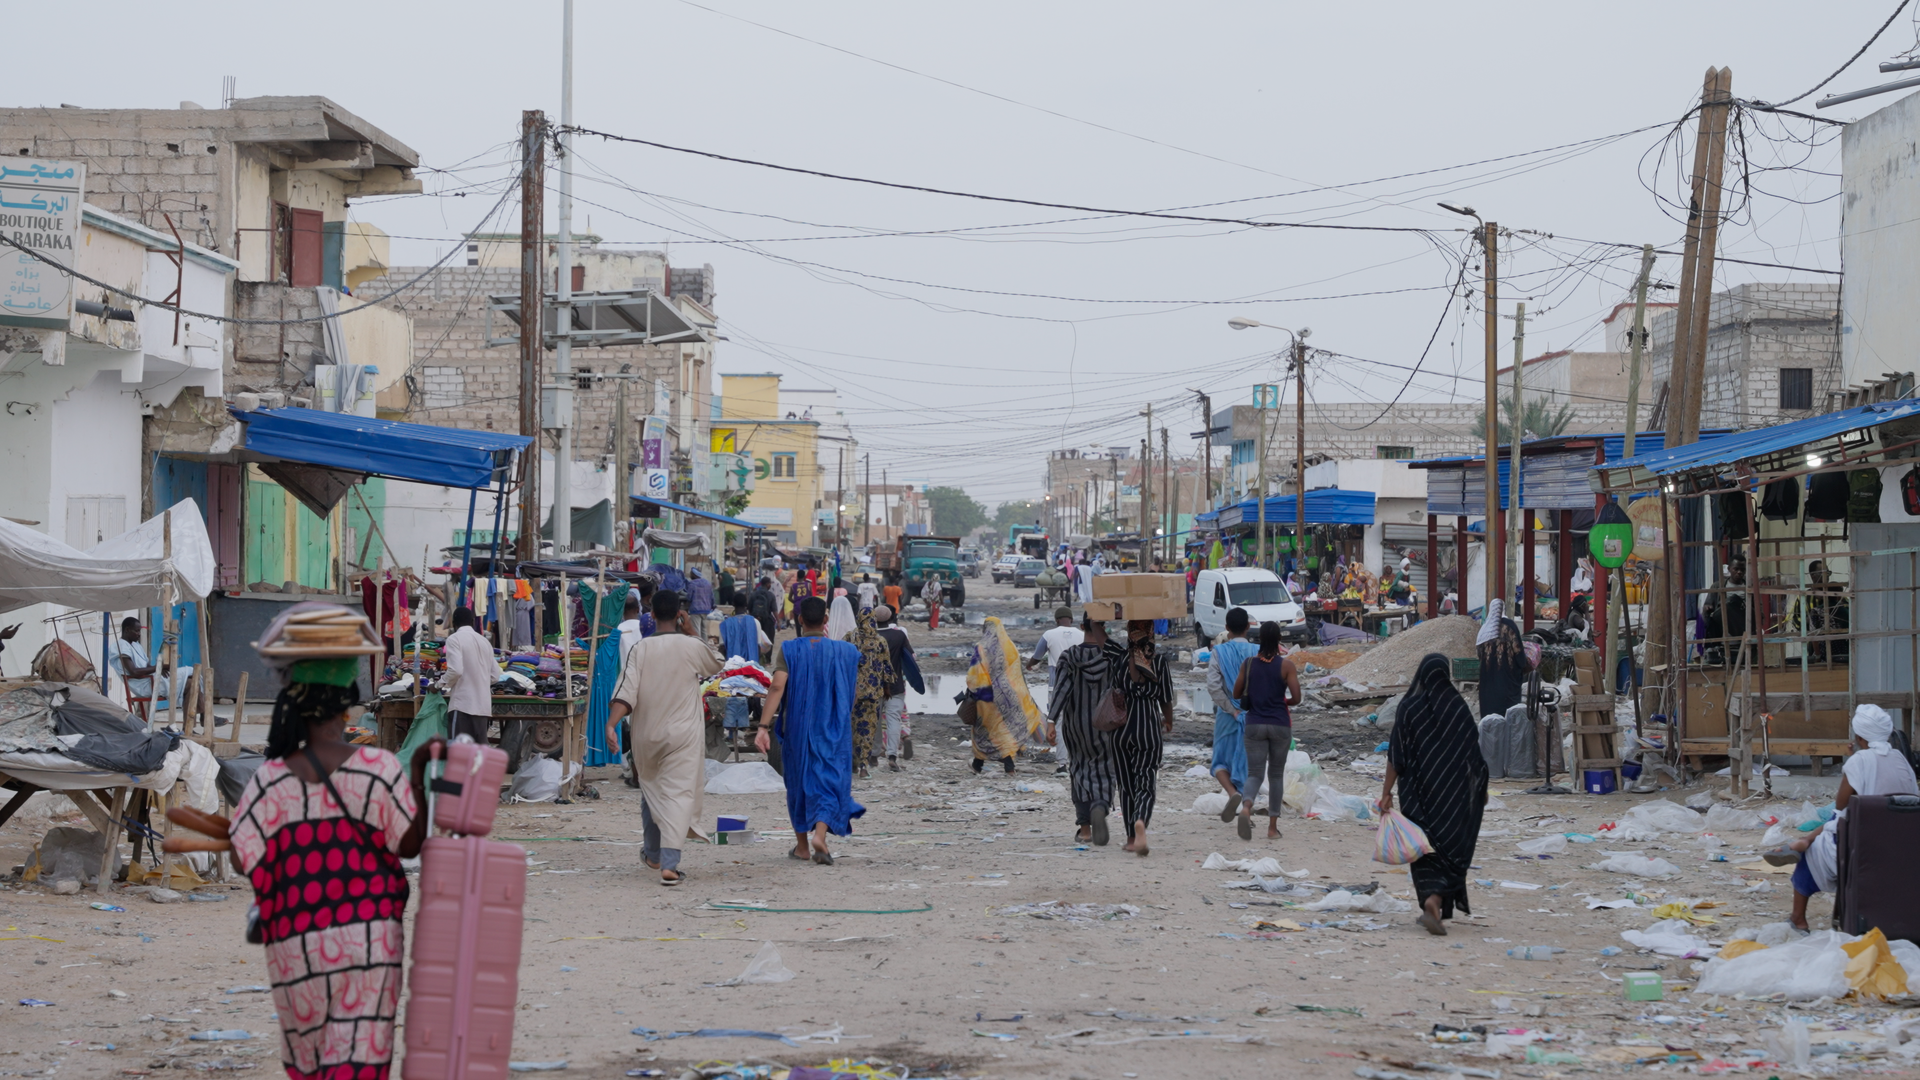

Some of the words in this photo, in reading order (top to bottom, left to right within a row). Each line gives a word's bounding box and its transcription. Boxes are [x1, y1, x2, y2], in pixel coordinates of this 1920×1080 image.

[0, 213, 64, 232] BOUTIQUE
[13, 231, 72, 250] BARAKA
[3, 294, 52, 310] عامة
[796, 587, 808, 597] 23
